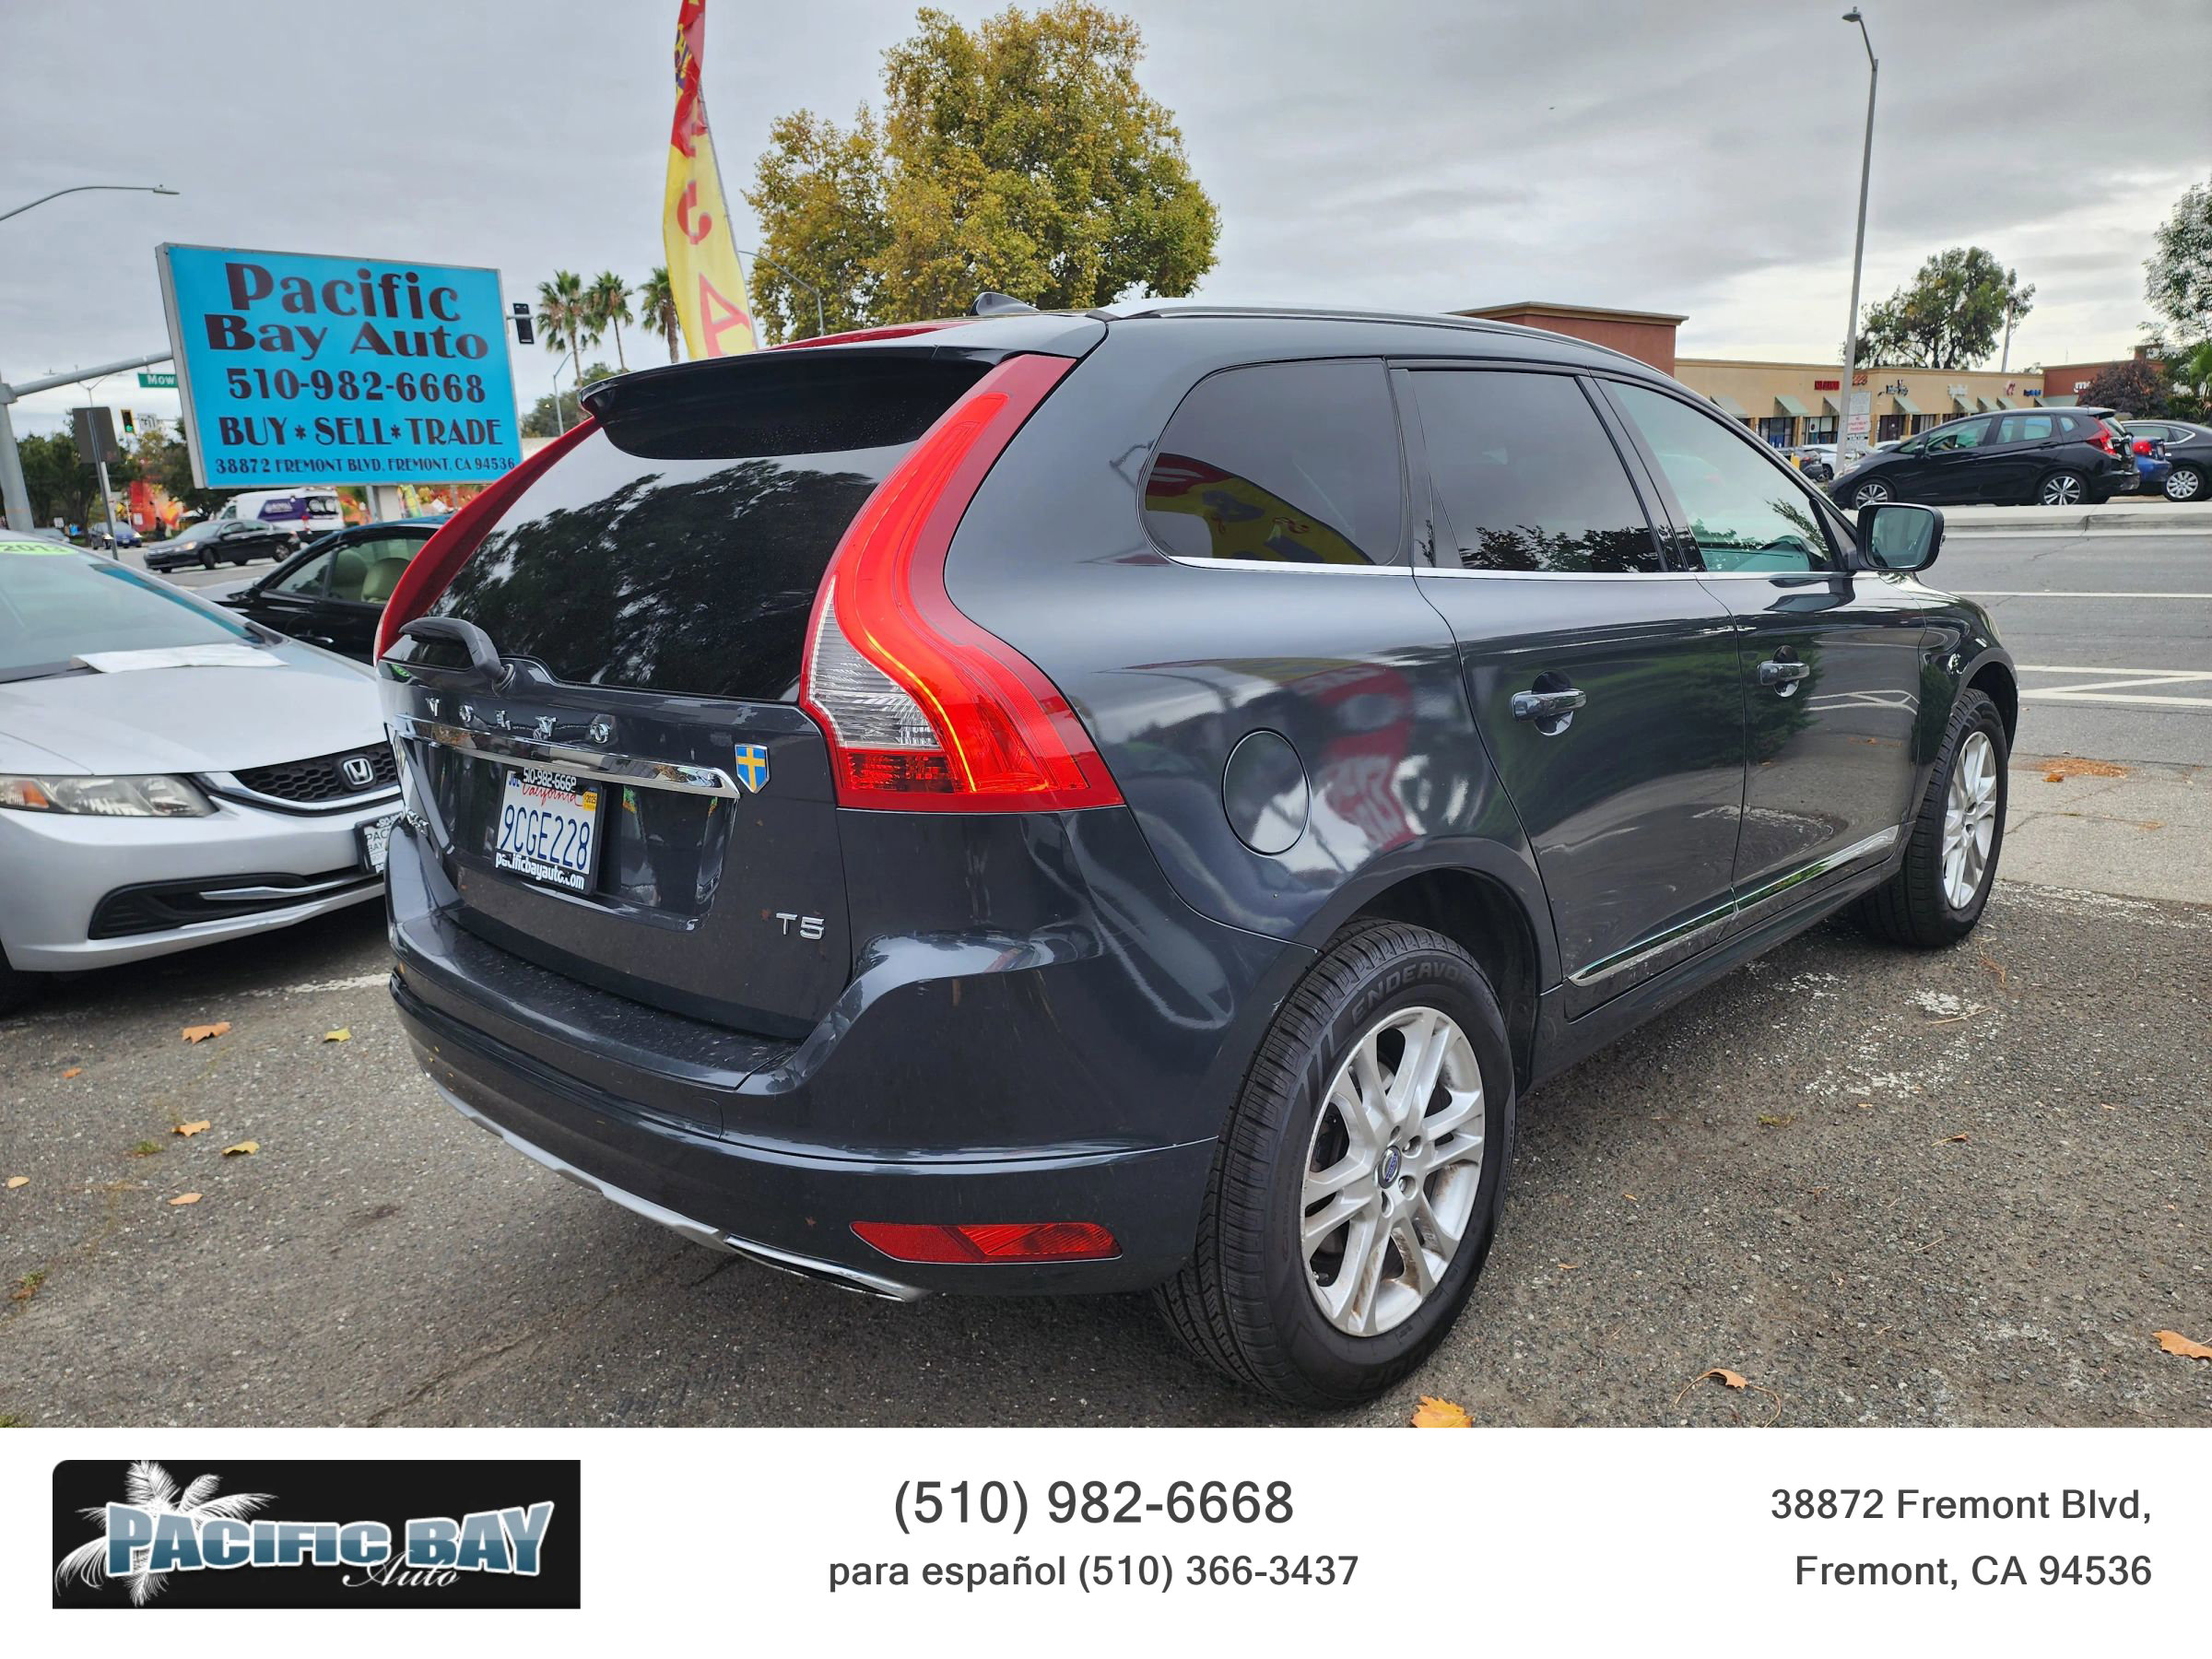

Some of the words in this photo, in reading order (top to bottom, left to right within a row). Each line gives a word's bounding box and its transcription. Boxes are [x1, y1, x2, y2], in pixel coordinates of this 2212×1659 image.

[225, 263, 461, 322] Pacific
[205, 314, 327, 360] Bay
[350, 321, 488, 359] Auto
[147, 374, 175, 385] Mow
[227, 369, 486, 403] 510-982-6668
[218, 417, 288, 445] BUY
[314, 417, 392, 445] SELL
[405, 418, 503, 445] TRADE
[216, 459, 271, 474] 38872
[276, 459, 343, 473] FREMONT
[455, 458, 472, 470] CA
[475, 457, 515, 470] 94536
[426, 698, 610, 744] VOLVO
[500, 804, 591, 870] 9CGE228
[776, 912, 825, 940] T5
